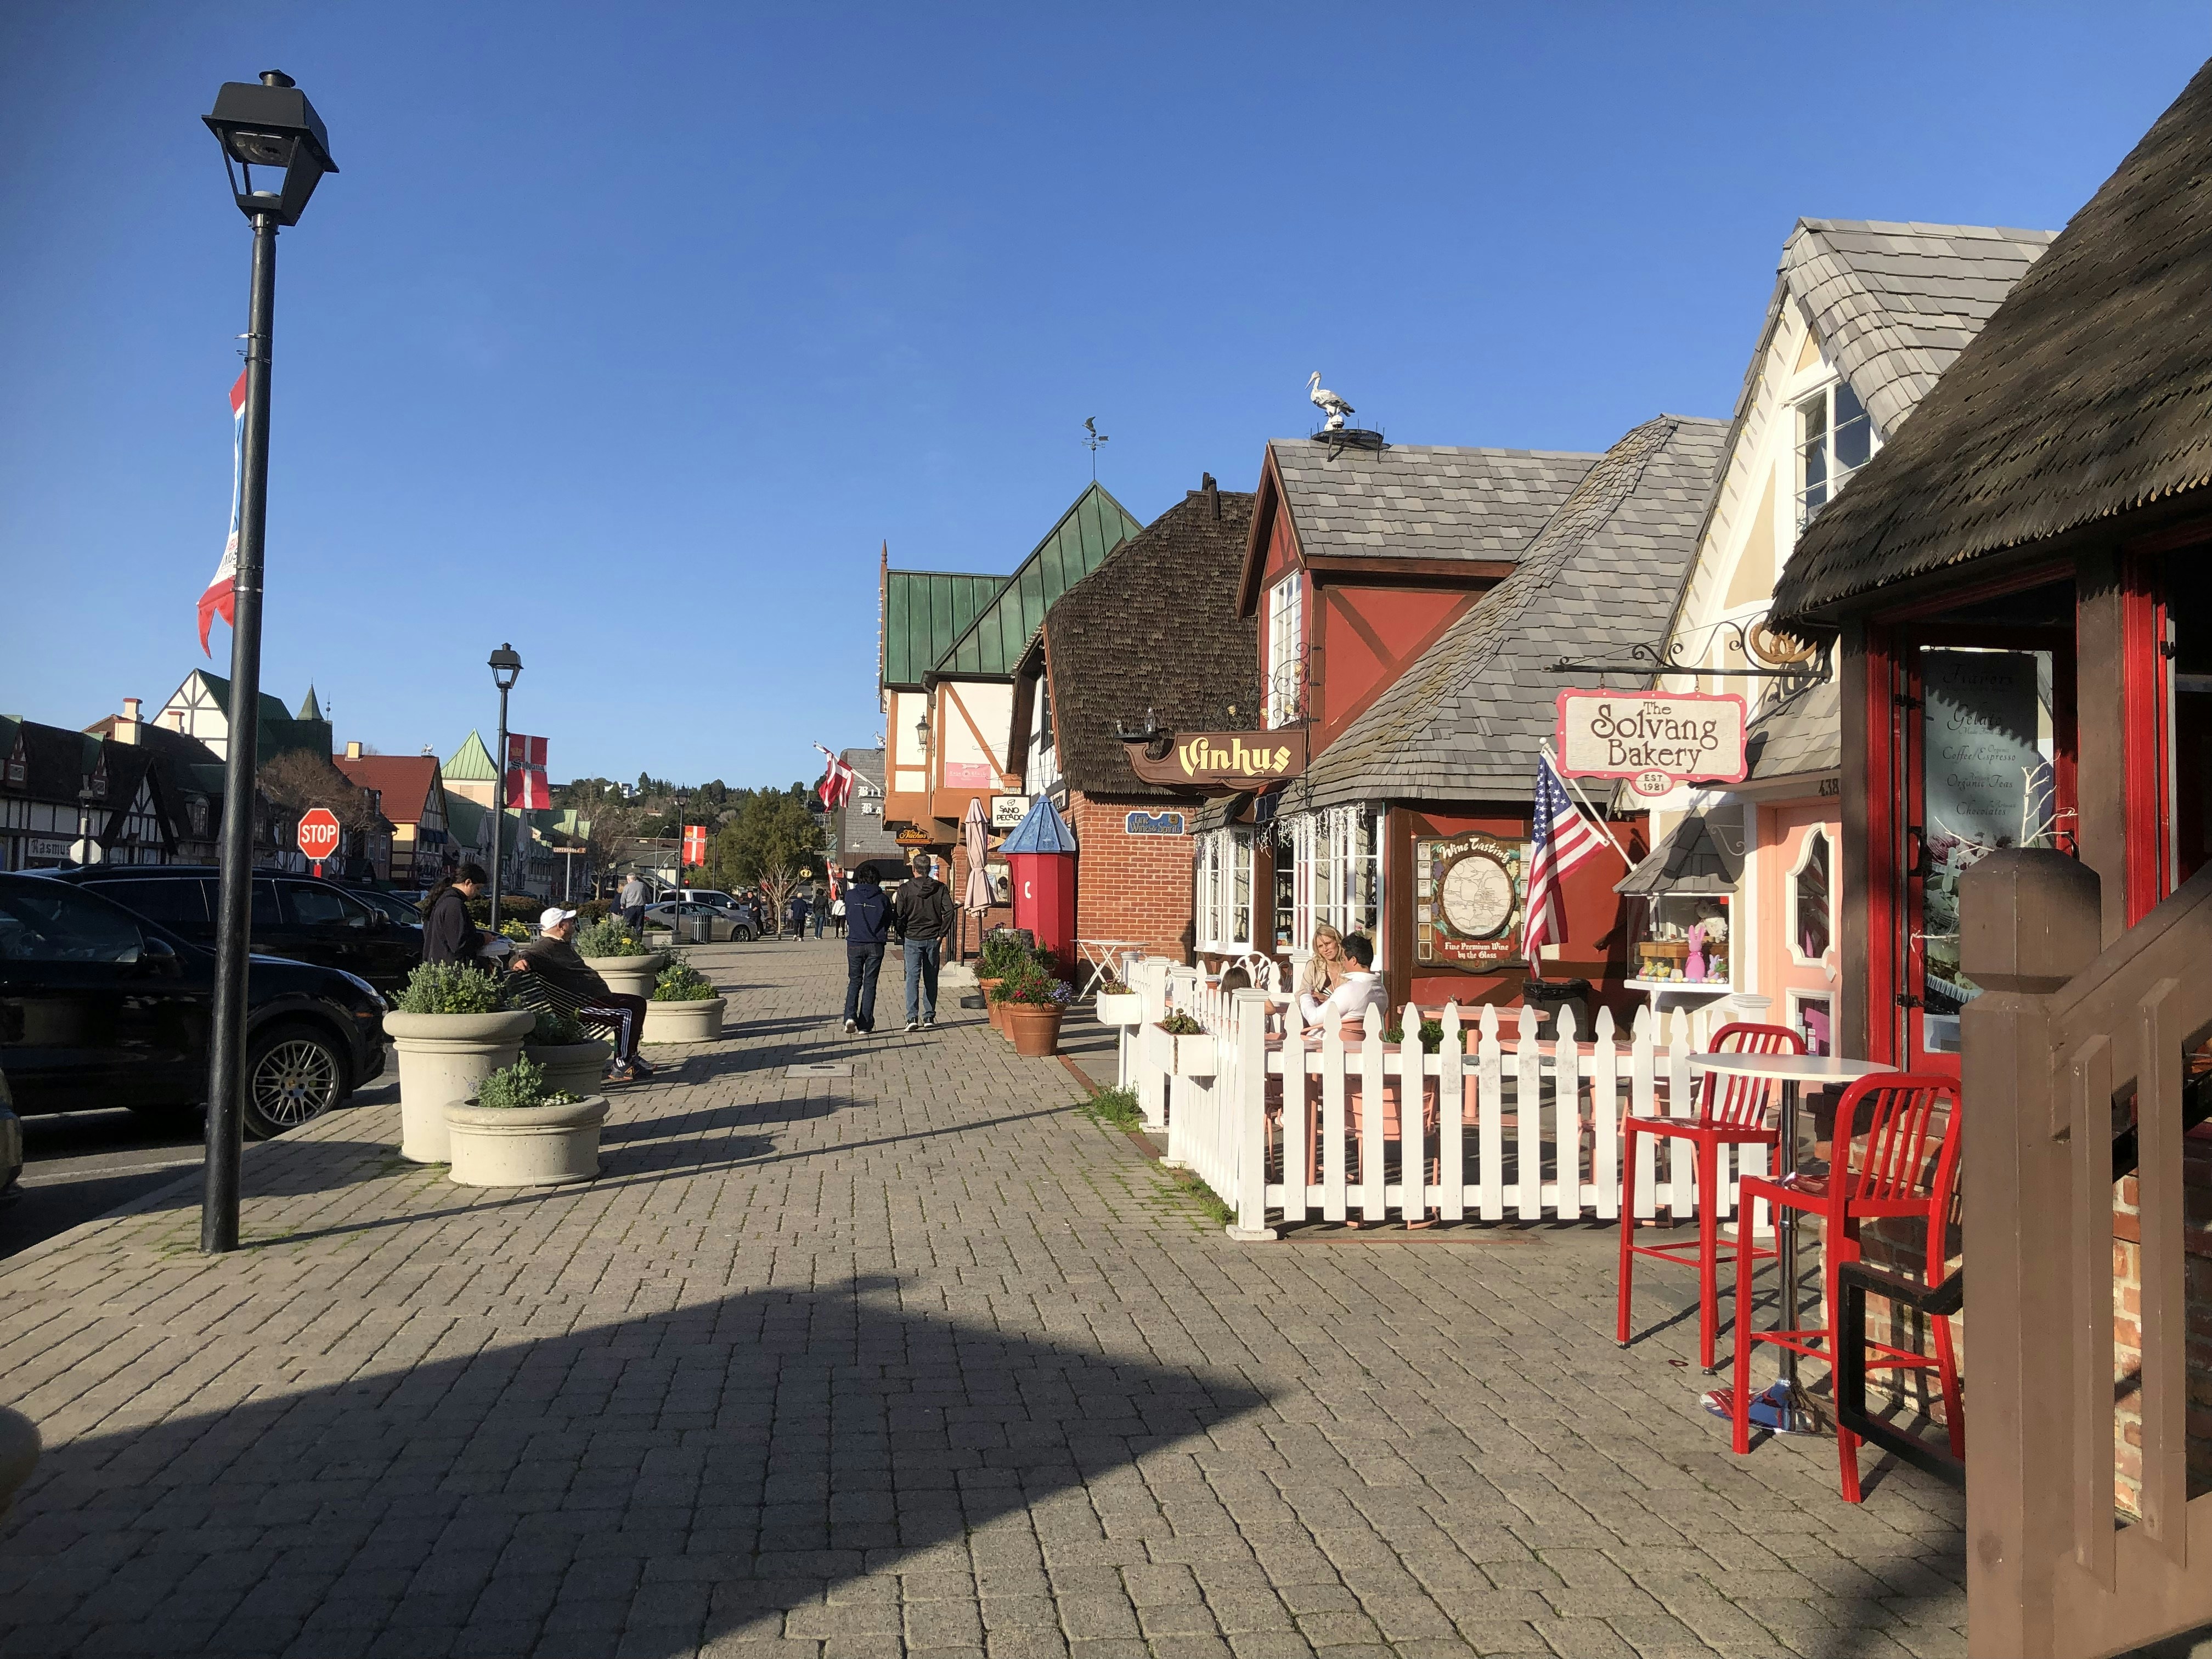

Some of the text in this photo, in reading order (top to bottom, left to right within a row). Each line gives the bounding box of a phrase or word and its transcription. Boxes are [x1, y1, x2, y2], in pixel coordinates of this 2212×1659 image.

[1643, 701, 1672, 715] The
[1947, 702, 2002, 730] Gelato
[1590, 704, 1718, 751] Solvang
[1179, 737, 1291, 777] Vinhus
[1608, 738, 1702, 773] Bakery
[511, 757, 544, 772] Solvang
[1947, 774, 2013, 791] Organic Teas
[999, 805, 1019, 814] SANO
[1956, 800, 2006, 816] Chocolates
[1129, 821, 1152, 832] Wines
[1157, 821, 1181, 834] Spirits
[1135, 815, 1149, 824] Fine
[301, 825, 336, 843] STOP
[1440, 837, 1510, 864] Wine Tasting
[1444, 942, 1509, 951] Fine Premium Wine
[1458, 951, 1466, 959] by
